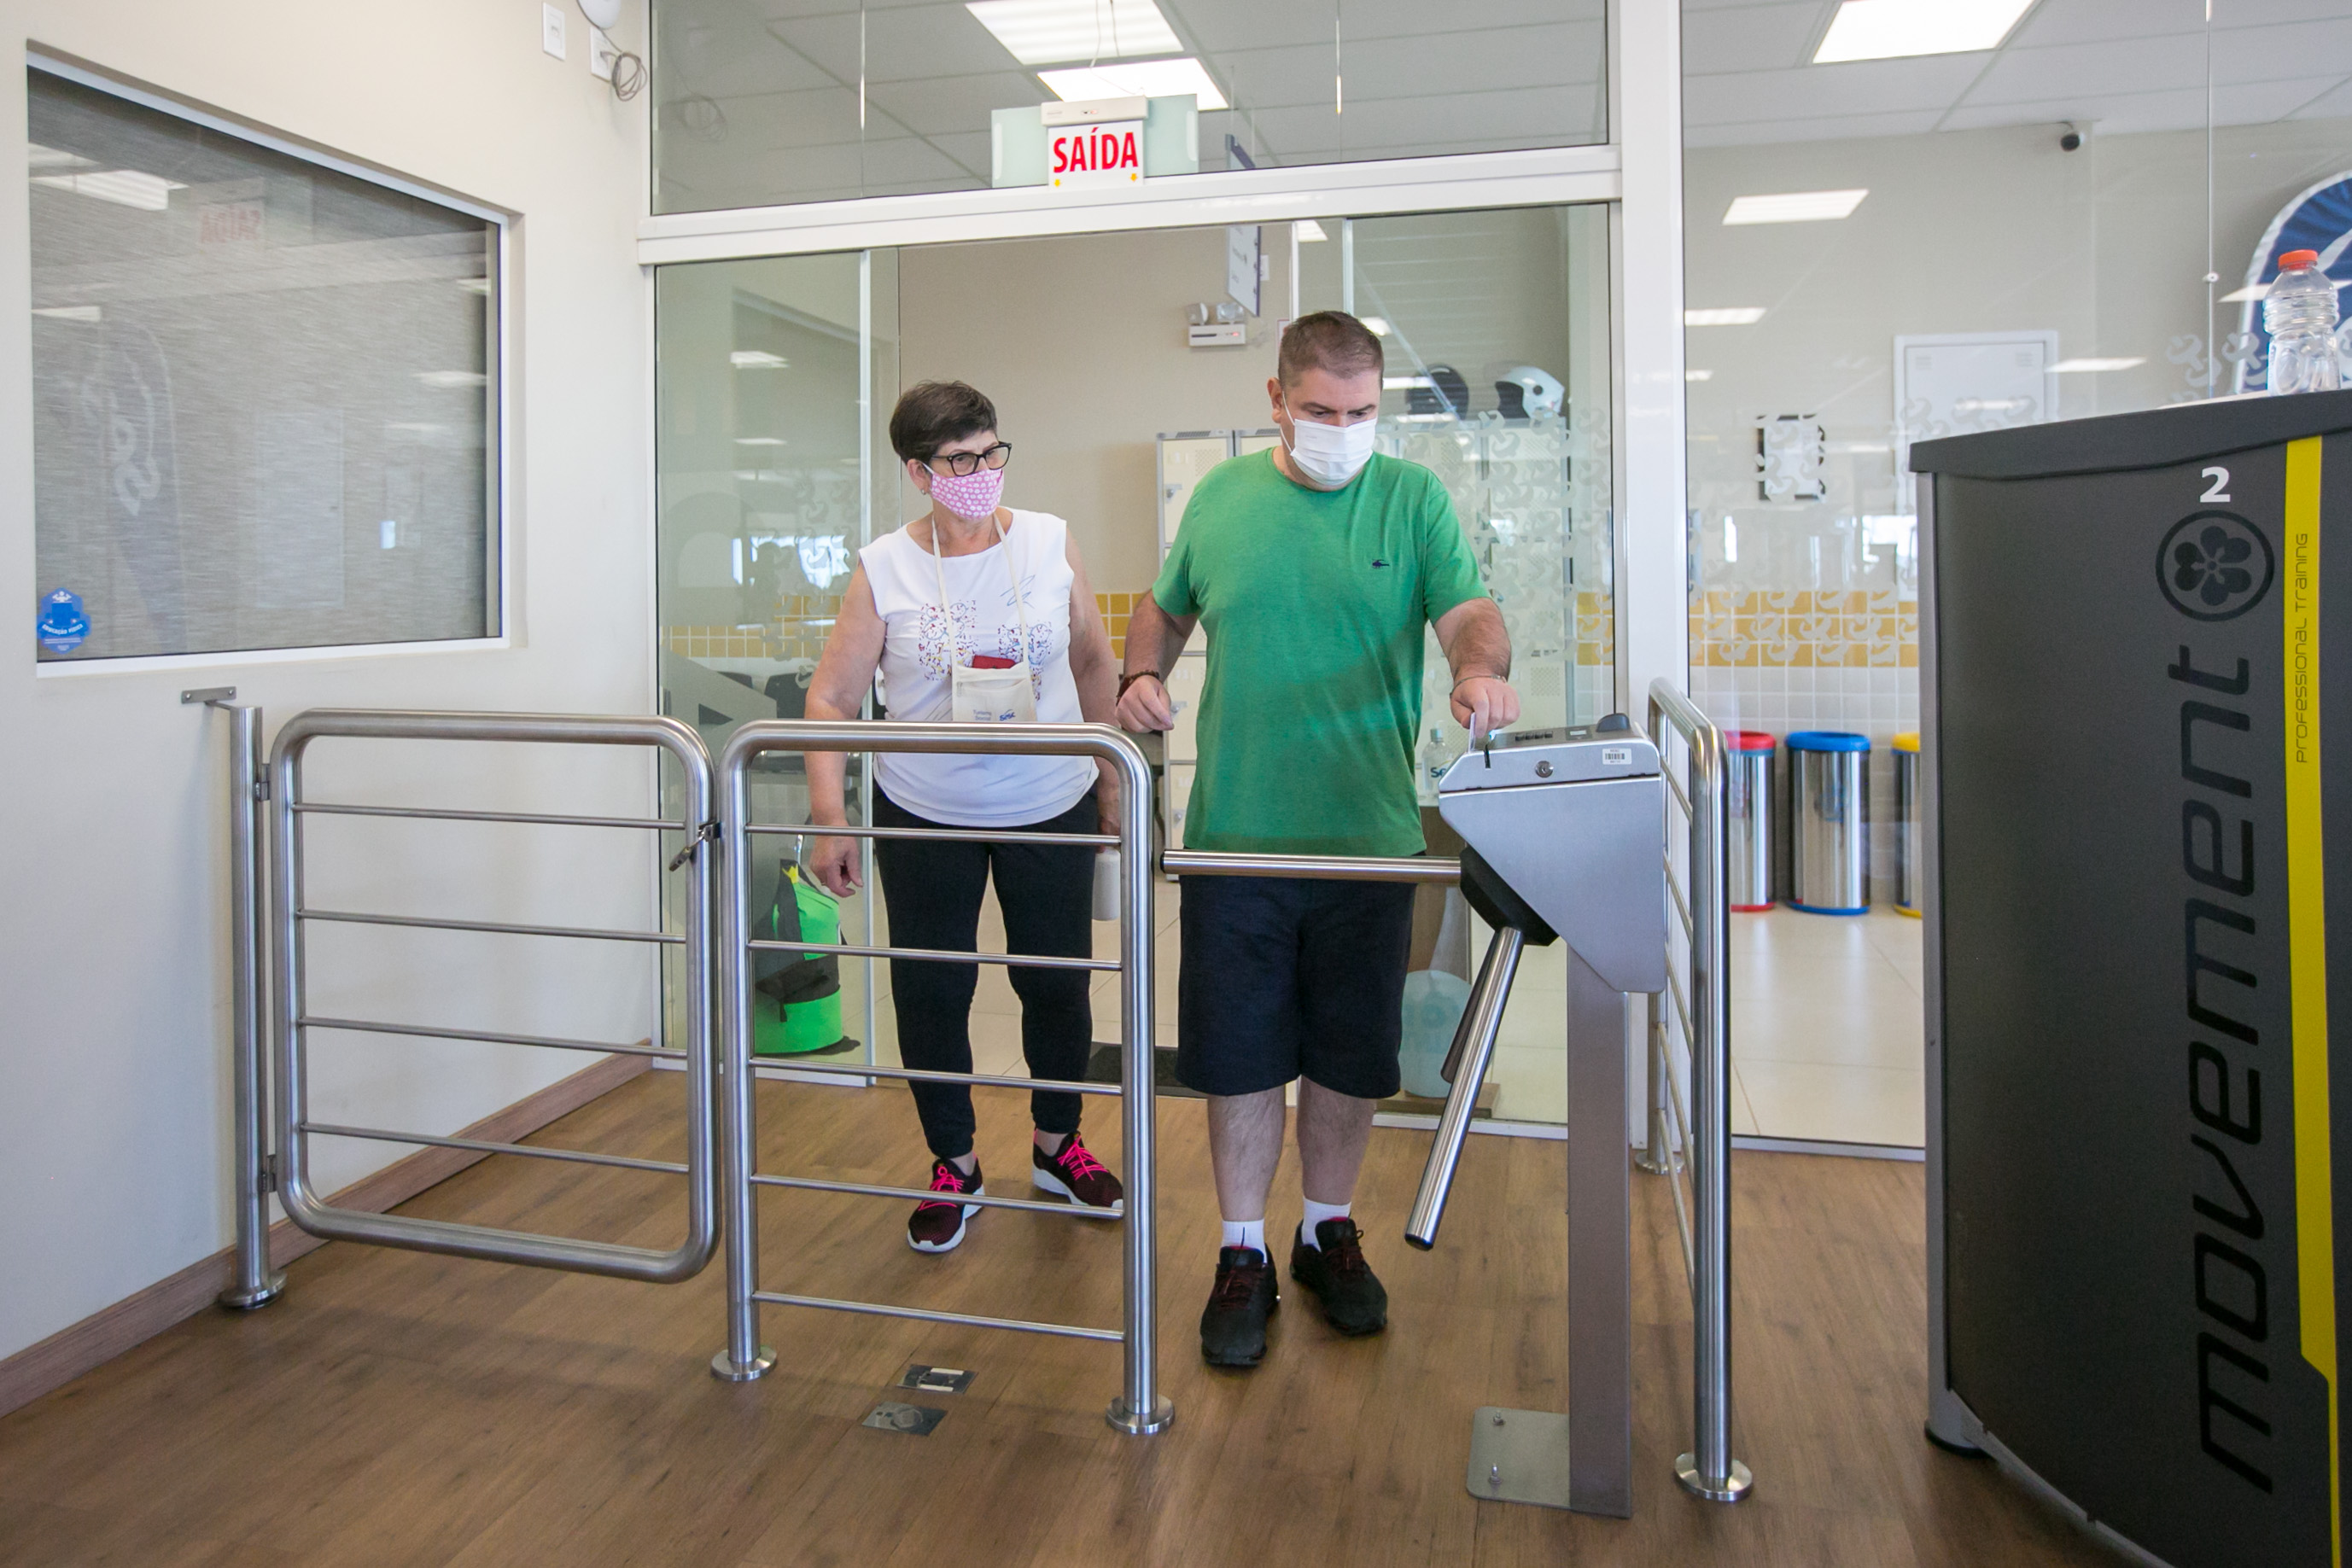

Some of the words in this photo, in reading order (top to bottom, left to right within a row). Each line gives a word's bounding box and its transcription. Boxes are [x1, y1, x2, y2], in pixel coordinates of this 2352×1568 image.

[1053, 127, 1139, 173] SAÍDA
[2199, 467, 2231, 503] 2
[2168, 644, 2273, 1495] movement
